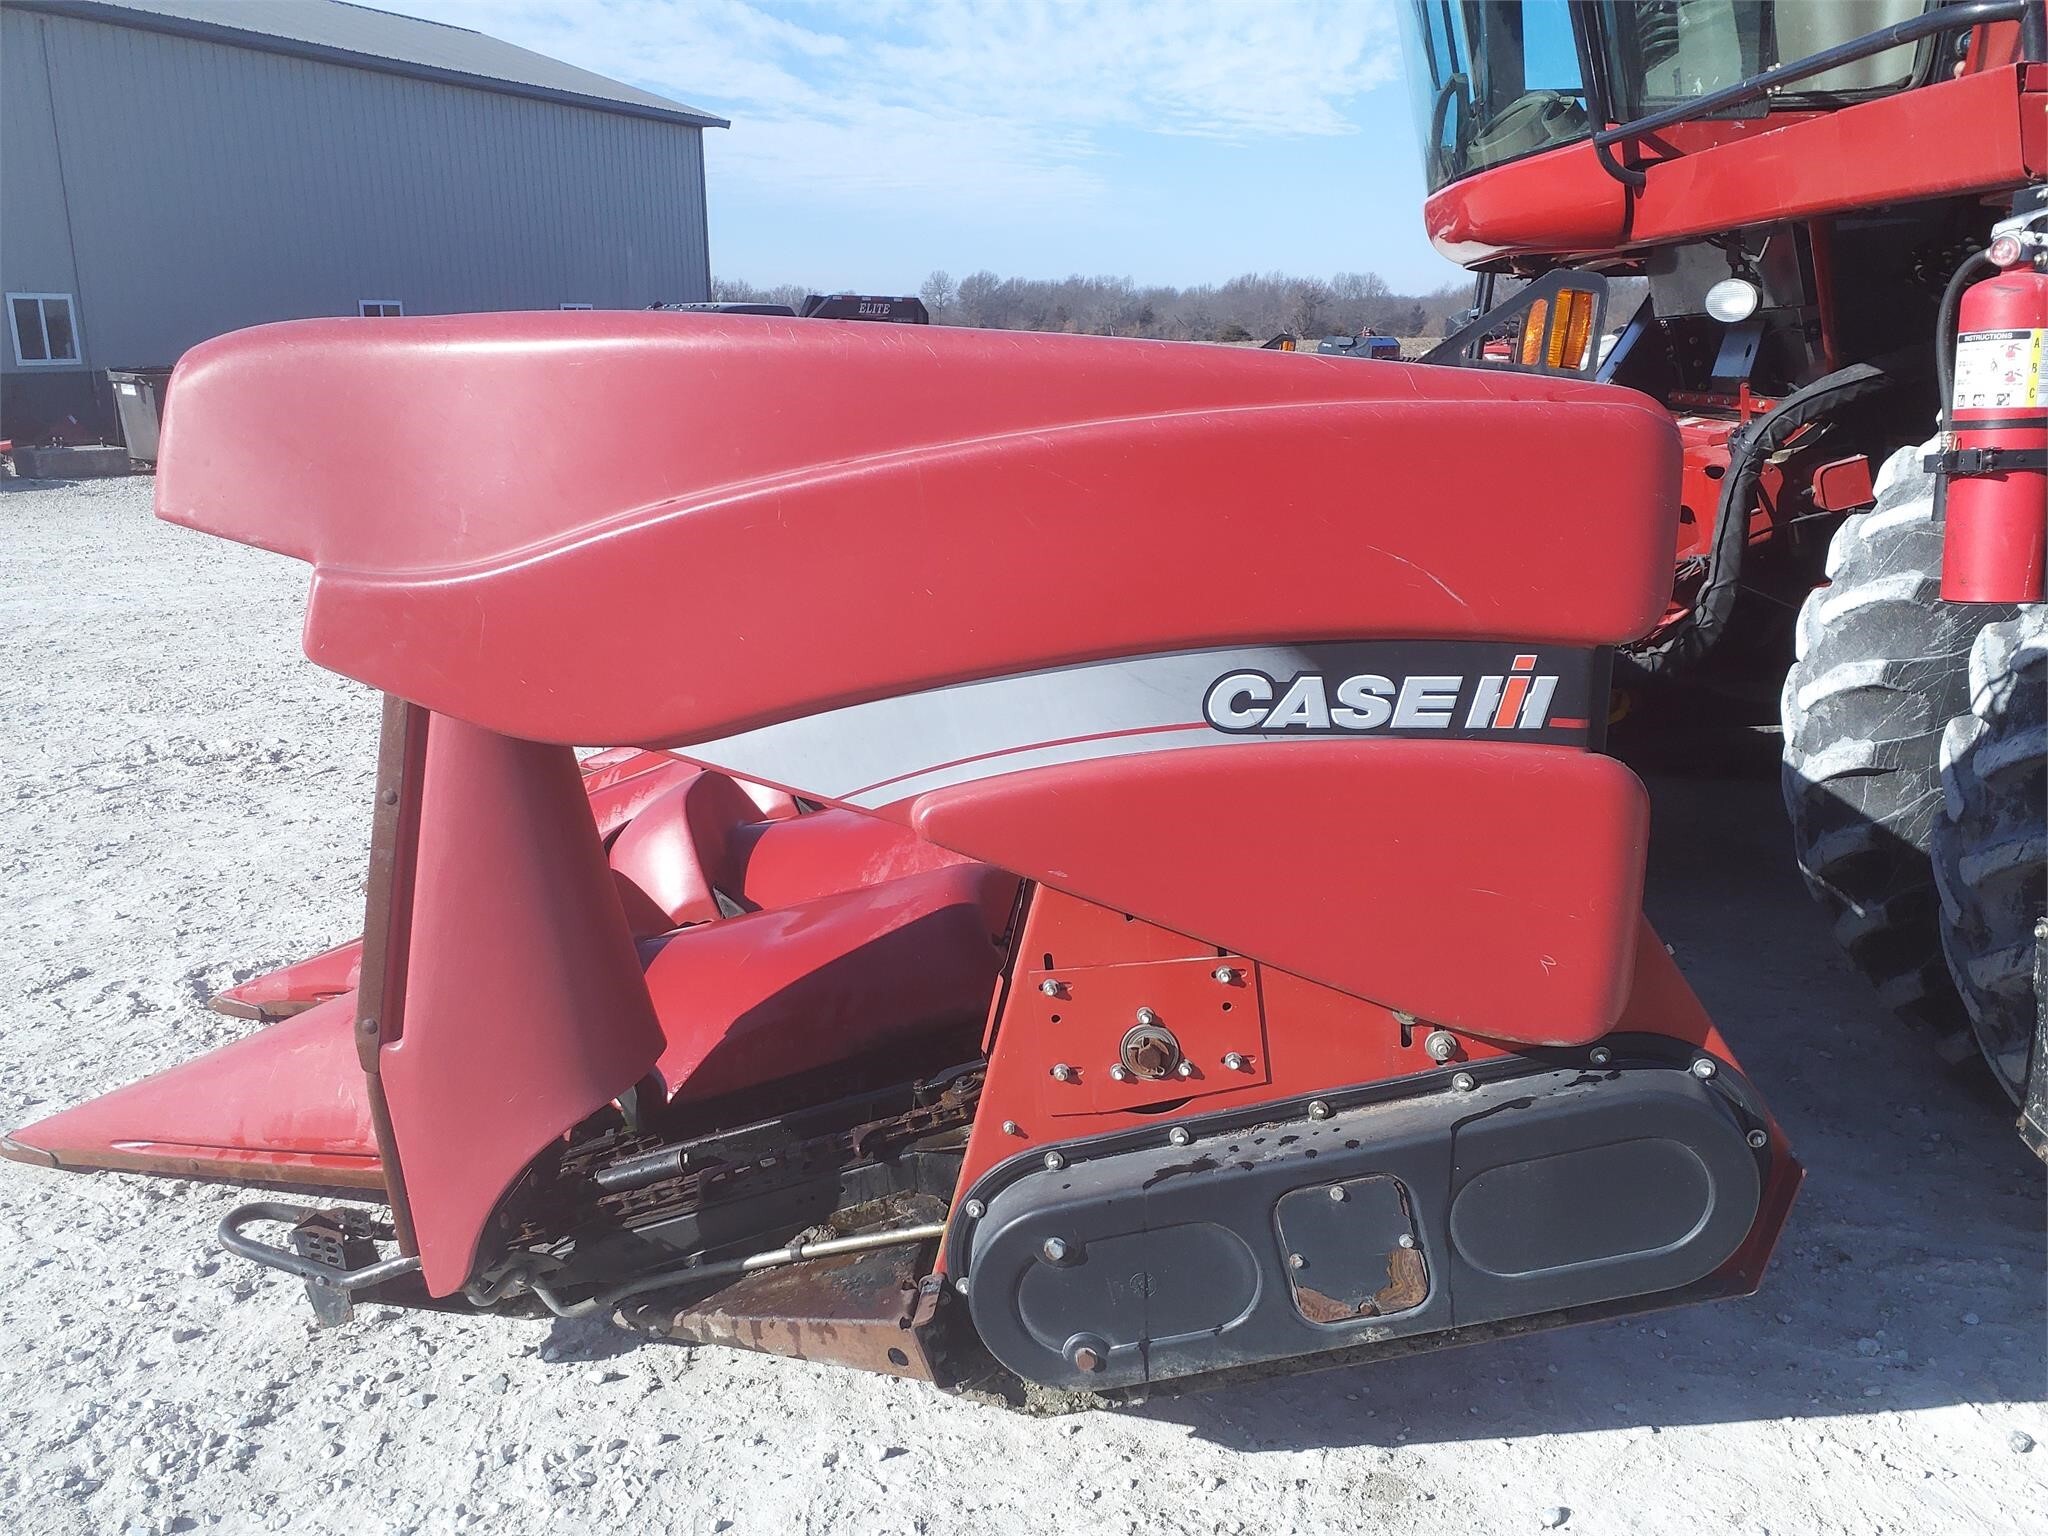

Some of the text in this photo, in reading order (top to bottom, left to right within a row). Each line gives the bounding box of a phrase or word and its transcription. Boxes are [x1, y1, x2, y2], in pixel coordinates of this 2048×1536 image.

[859, 302, 891, 314] ELITE
[1964, 332, 2013, 342] INSTRUCTIONS
[2034, 337, 2040, 349] A
[2032, 362, 2038, 373] B
[2029, 387, 2036, 399] C
[1207, 674, 1464, 730] CASE
